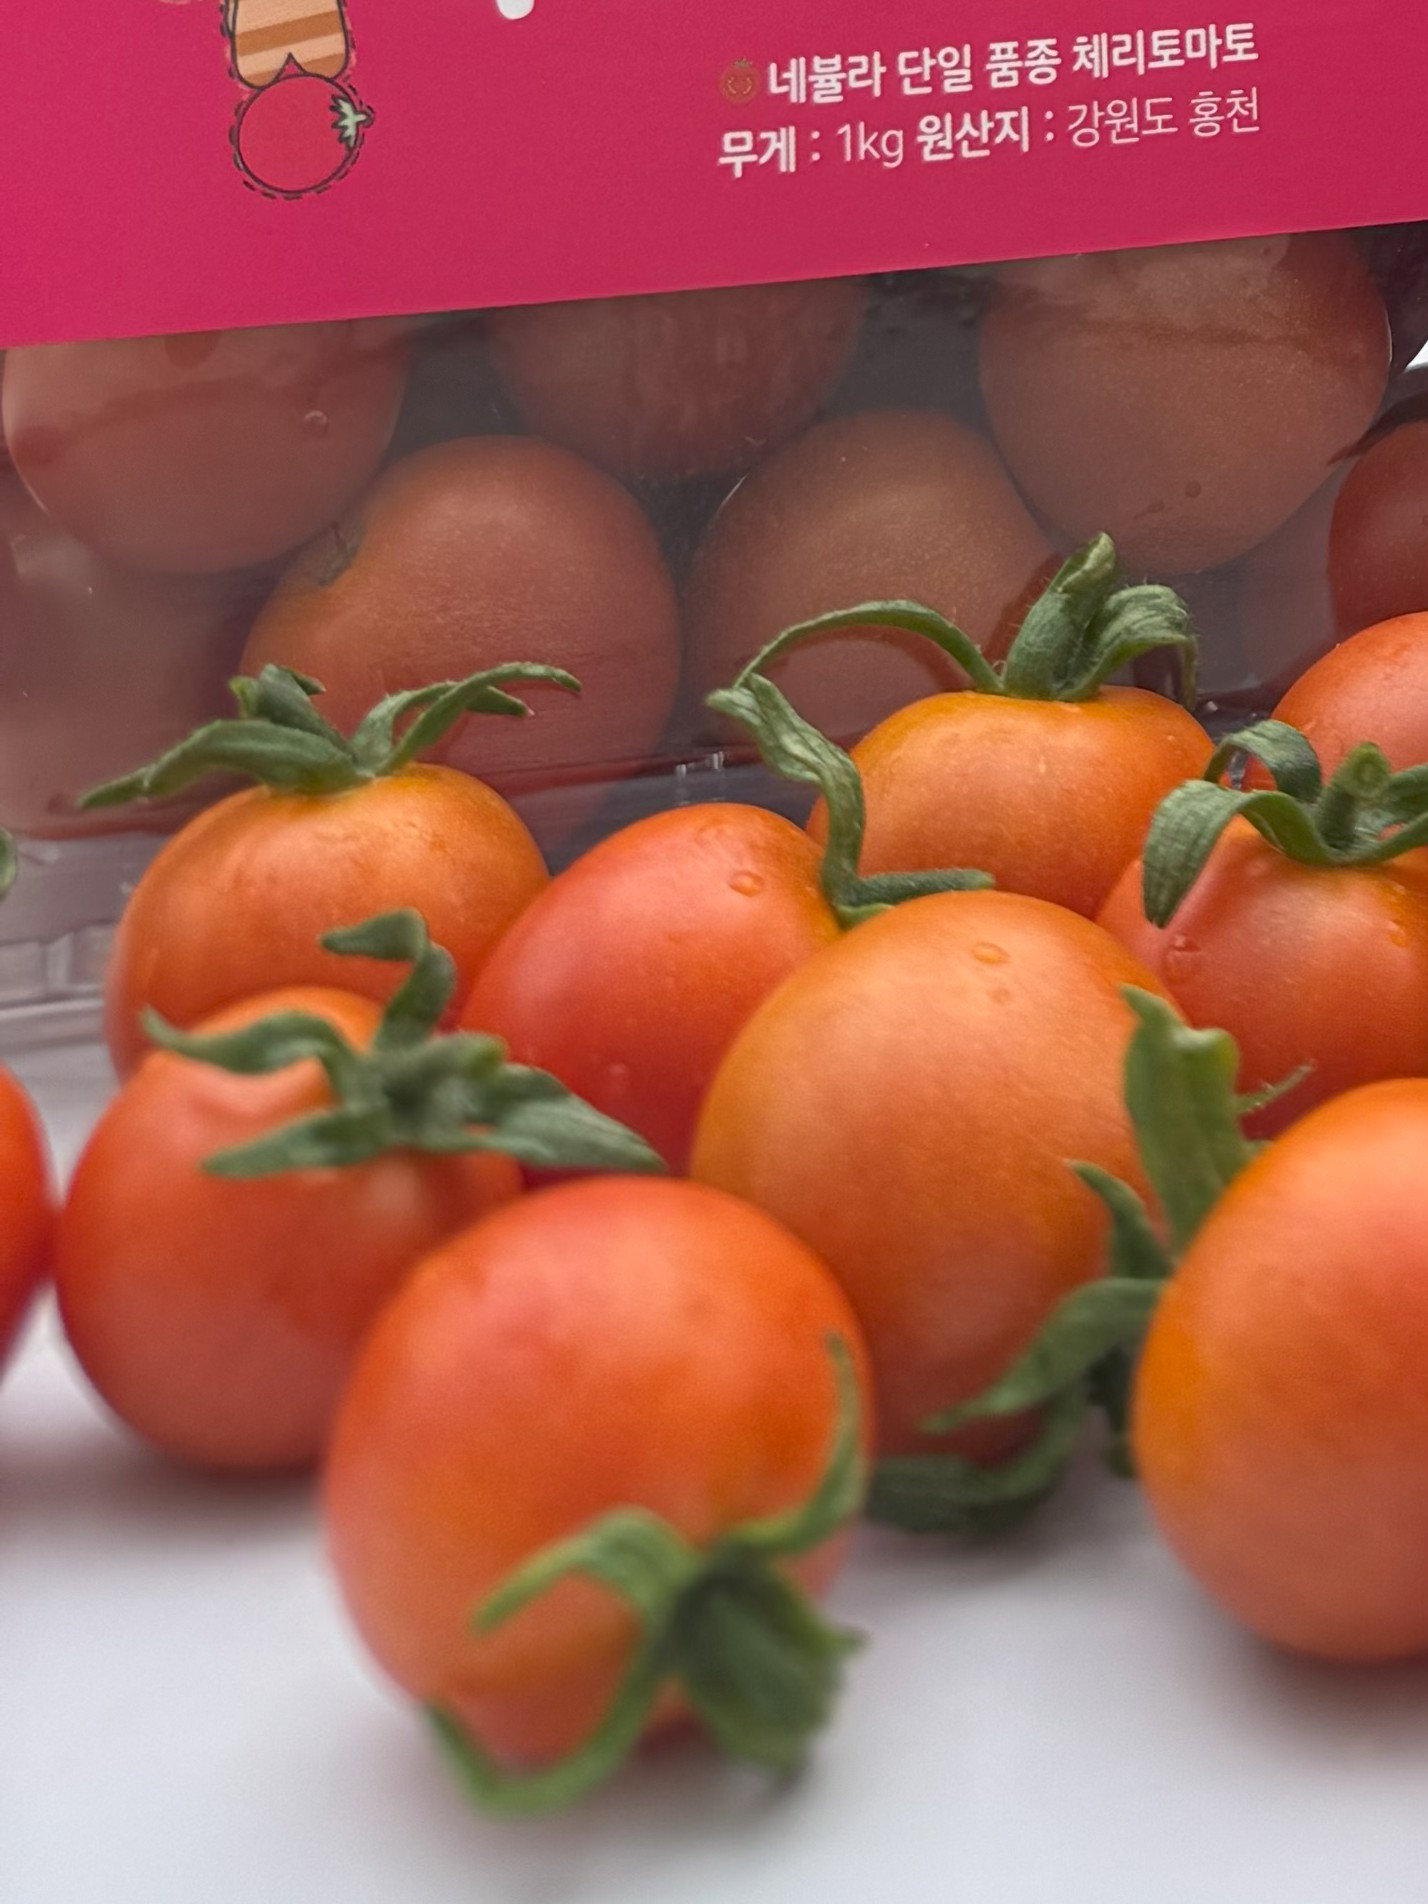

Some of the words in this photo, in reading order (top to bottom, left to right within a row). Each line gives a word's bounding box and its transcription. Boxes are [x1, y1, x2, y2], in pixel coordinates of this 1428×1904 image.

[769, 52, 886, 103] 네뷸라
[898, 44, 972, 95] 단일
[986, 39, 1061, 88] 품종
[1073, 23, 1258, 78] 체리토마토
[719, 126, 795, 177] 무게
[838, 122, 903, 168] 1kg
[917, 106, 1028, 161] 원산지
[1068, 98, 1178, 147] 강원도
[1190, 87, 1259, 137] 홍천
